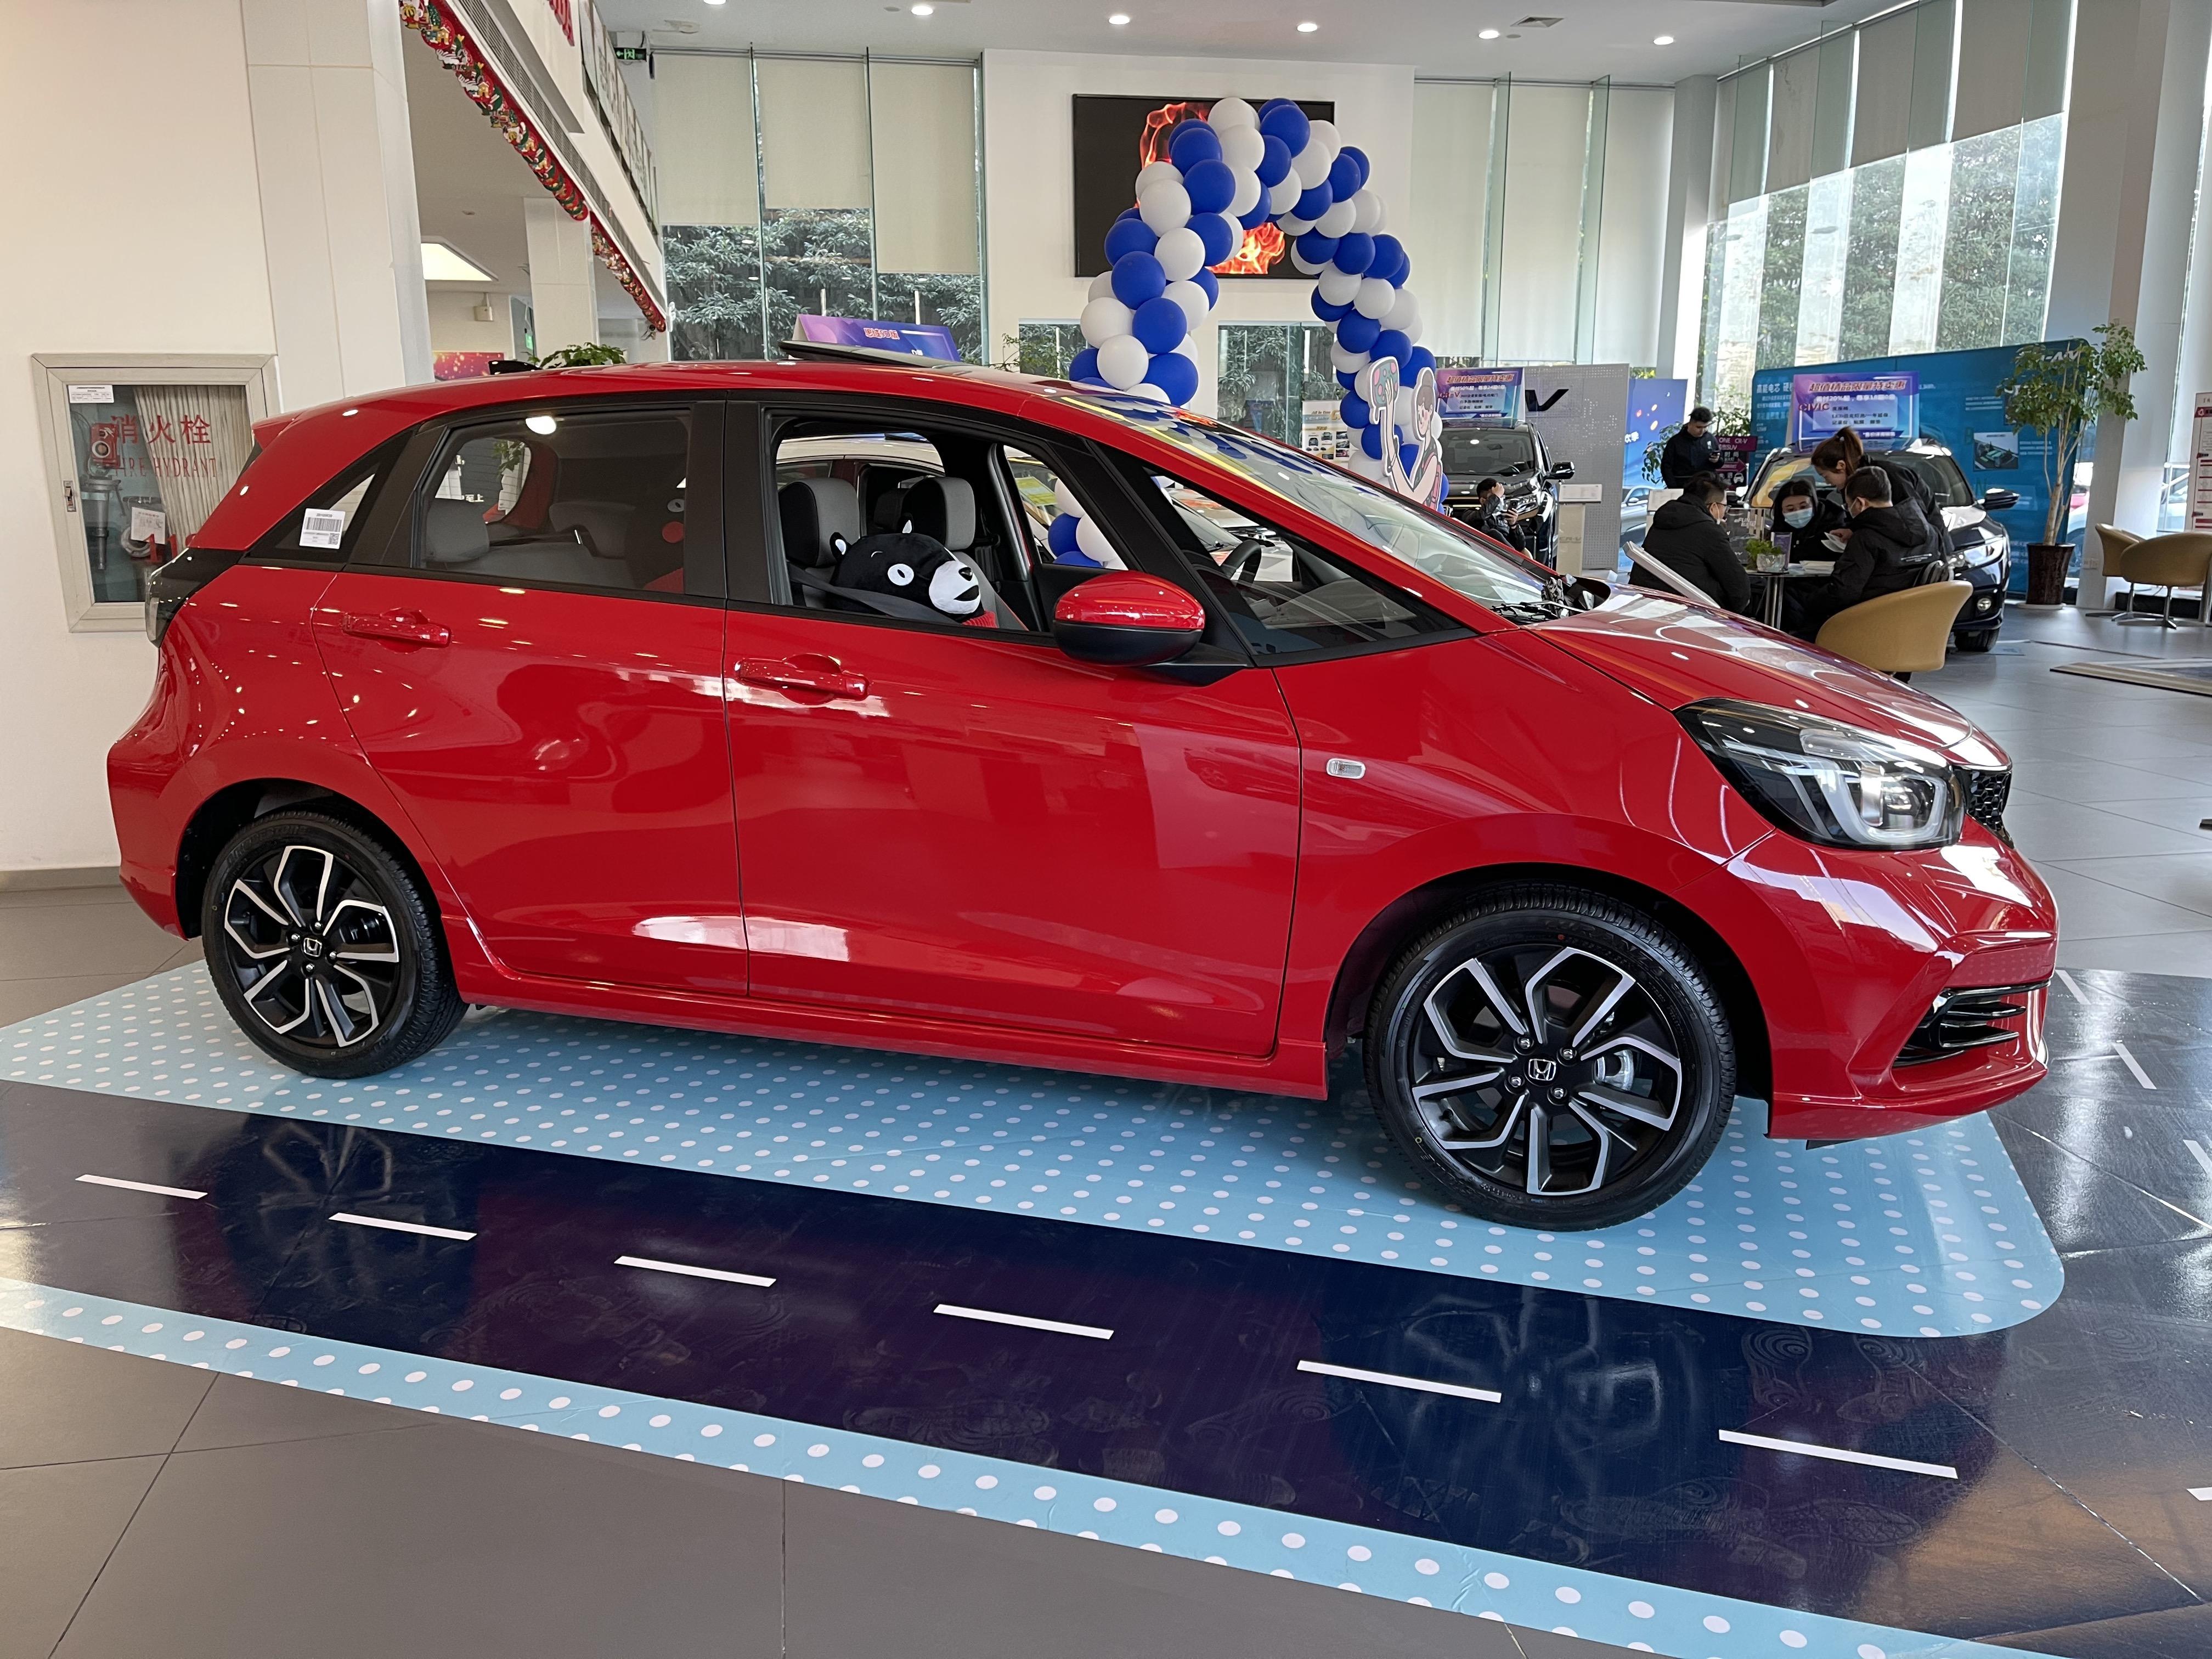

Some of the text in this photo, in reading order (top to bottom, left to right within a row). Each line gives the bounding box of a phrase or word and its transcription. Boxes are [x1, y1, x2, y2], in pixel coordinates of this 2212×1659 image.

[1799, 403, 1830, 411] CIVIC
[110, 414, 211, 444] 消火栓
[153, 458, 216, 477] HYDRANT
